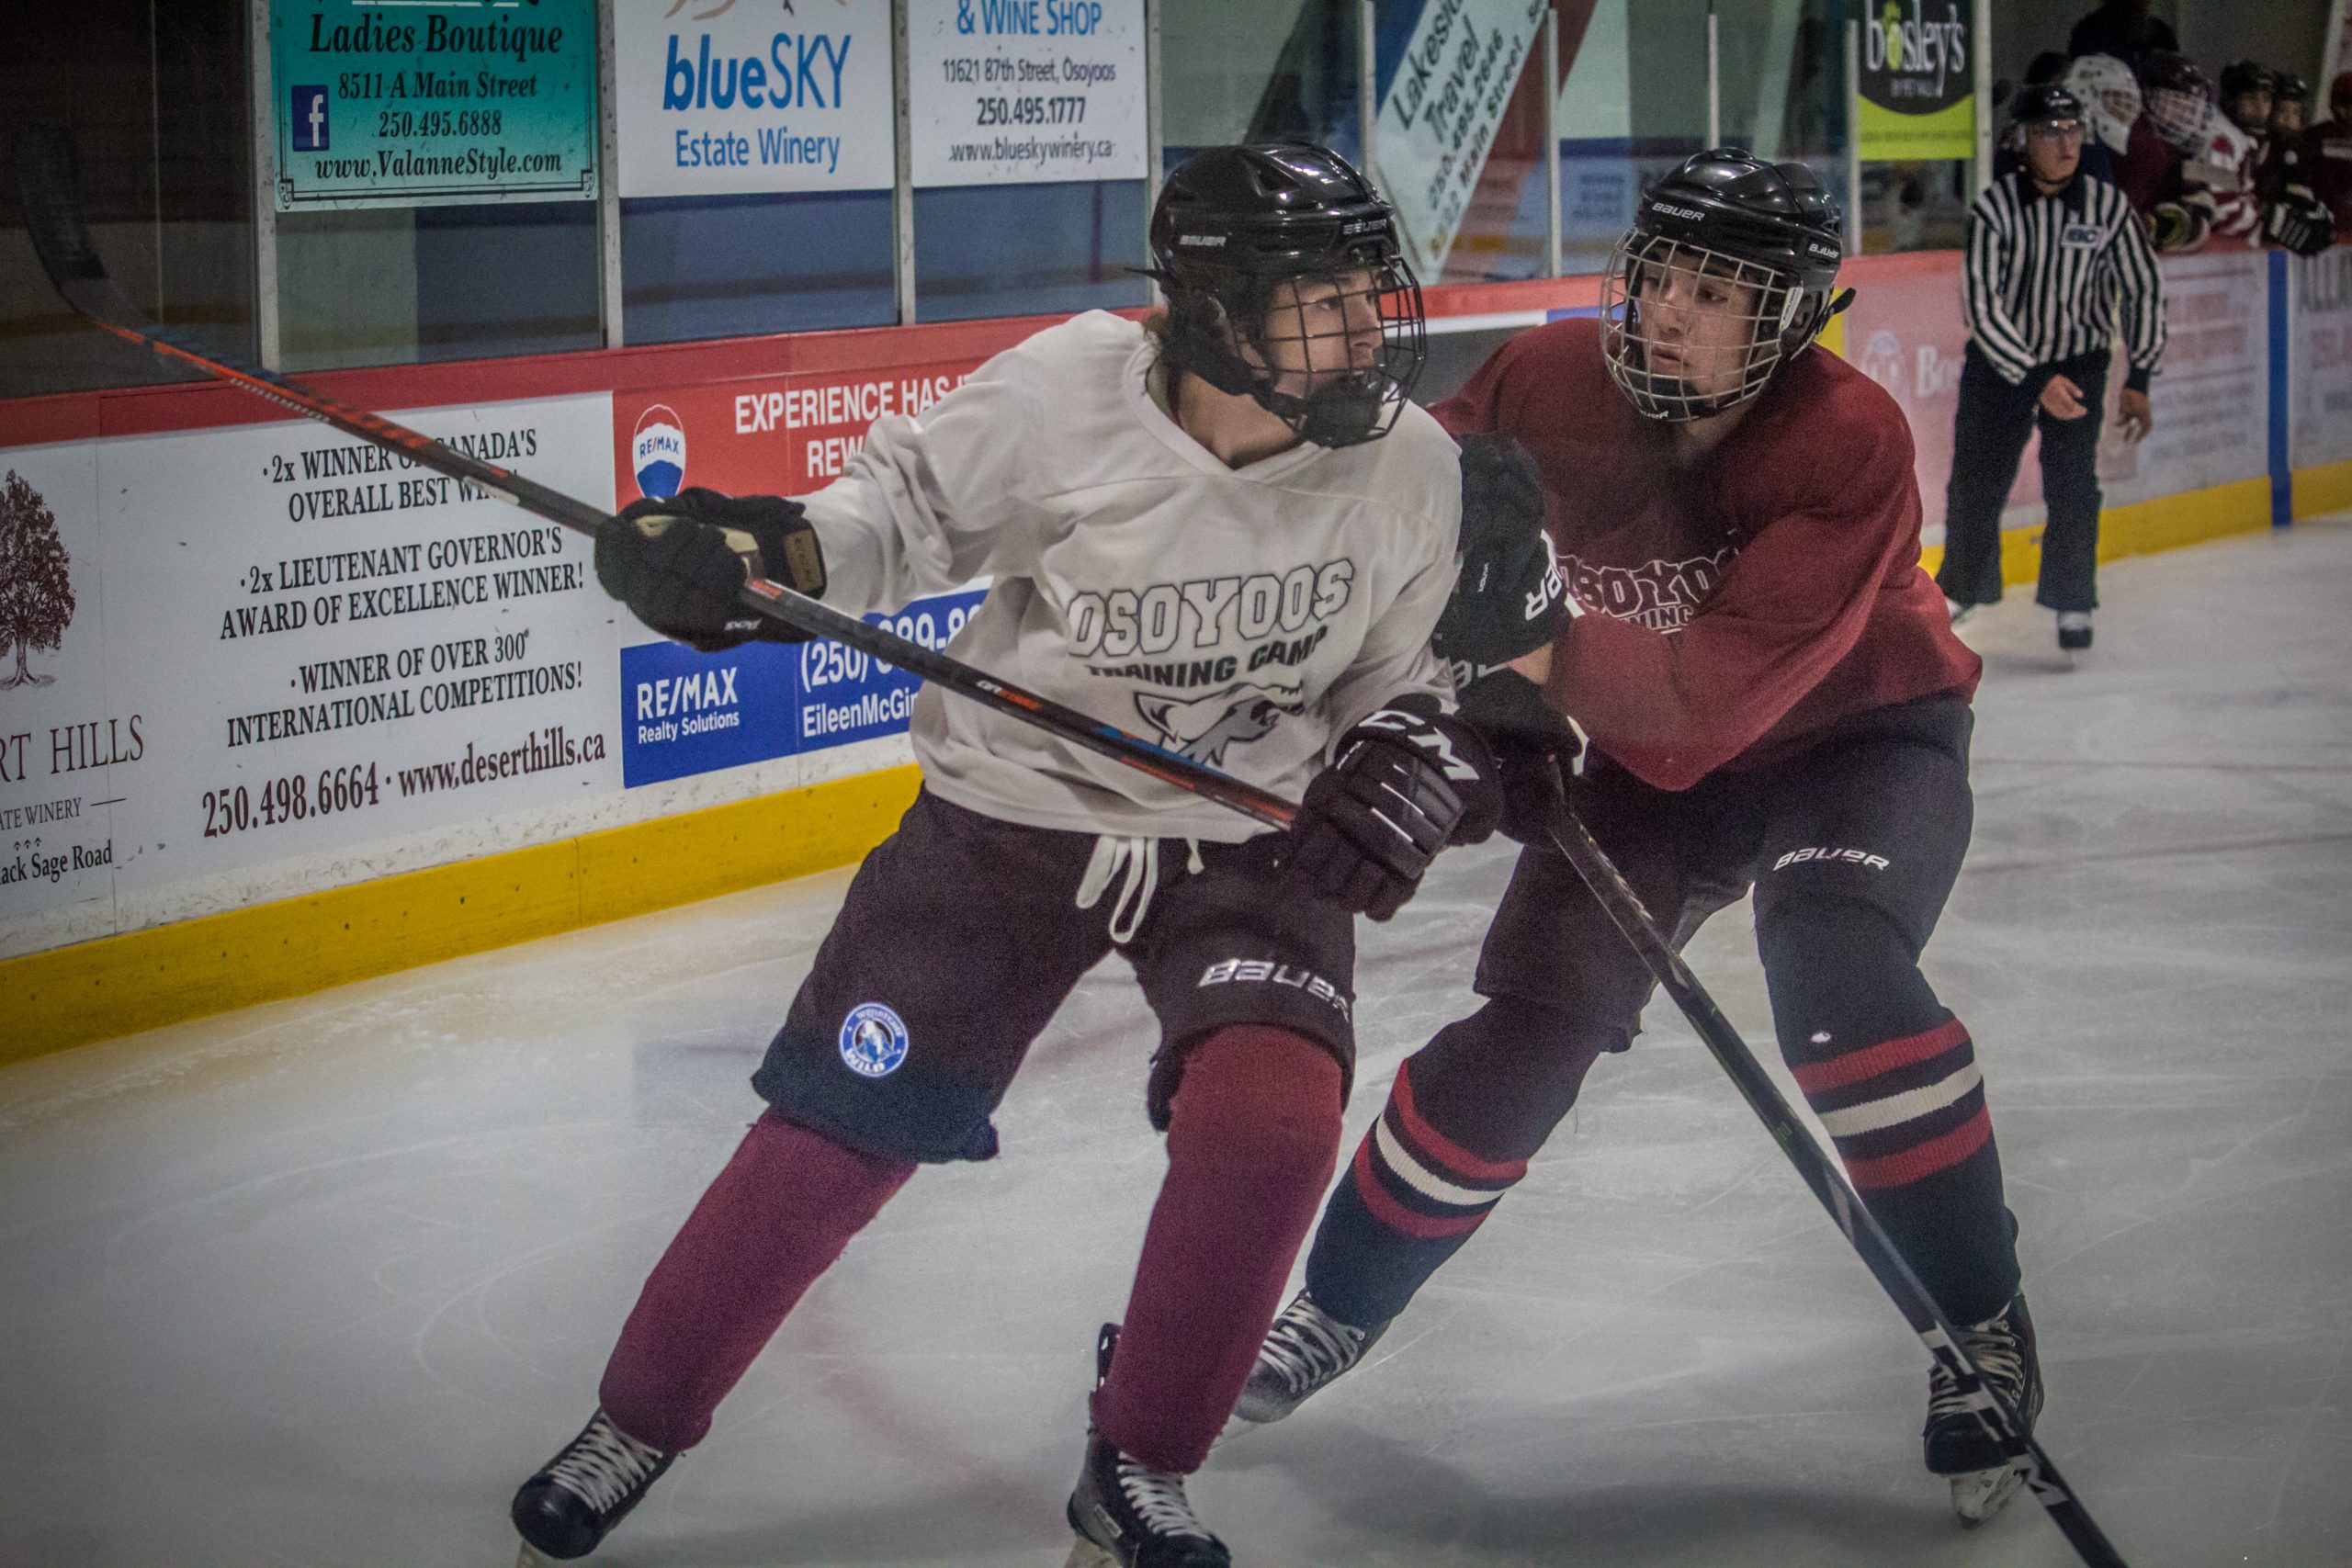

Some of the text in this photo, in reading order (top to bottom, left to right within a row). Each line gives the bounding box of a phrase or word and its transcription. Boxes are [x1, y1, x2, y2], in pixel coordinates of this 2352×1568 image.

[309, 13, 563, 62] Ladies Boutique
[956, 0, 1102, 35] & WINE SHOP
[662, 32, 852, 111] blueSKY
[943, 55, 1116, 86] 11621 87th Street, Osoyoos
[1864, 0, 1966, 97] bosley's
[413, 71, 470, 98] Main
[477, 71, 537, 97] Street
[1424, 14, 1481, 143] Travel
[379, 110, 502, 137] 250.495.6888
[977, 96, 1086, 125] 250.495.1777
[315, 147, 561, 180] www.ValanneStyle.com
[676, 126, 841, 175] Estate Winery
[950, 135, 1113, 165] www.blueskywinery.ca
[1653, 202, 1706, 221] BAUER
[734, 376, 950, 434] EXPERIENCE HAS
[300, 446, 393, 480] WINNER
[639, 434, 680, 460] RE/MAX
[288, 484, 393, 523] OVERALL
[398, 477, 451, 509] BEST
[278, 544, 423, 591] LIEUTENANT
[427, 526, 562, 570] GOVERNOR'S
[220, 562, 584, 640] AWARD OF EXCELLENCE WINNER!
[1068, 558, 1355, 658] OSOYOOS
[299, 652, 391, 694] WINNER
[397, 648, 424, 679] OF
[430, 638, 490, 674] OVER
[1085, 626, 1329, 688] TRAINING CAMP
[227, 661, 583, 749] INTERNATIONAL COMPETITIONS!
[637, 667, 739, 721] RE/MAX
[50, 714, 144, 774] HILLS
[638, 710, 740, 745] Realty Solutions
[201, 726, 606, 839] 250.498.6664 www.deserthills.ca
[25, 797, 83, 826] WINERY
[31, 852, 68, 883] Sage
[72, 838, 113, 871] Road
[1773, 847, 1890, 872] BAUER
[1197, 958, 1350, 1023] BAUER
